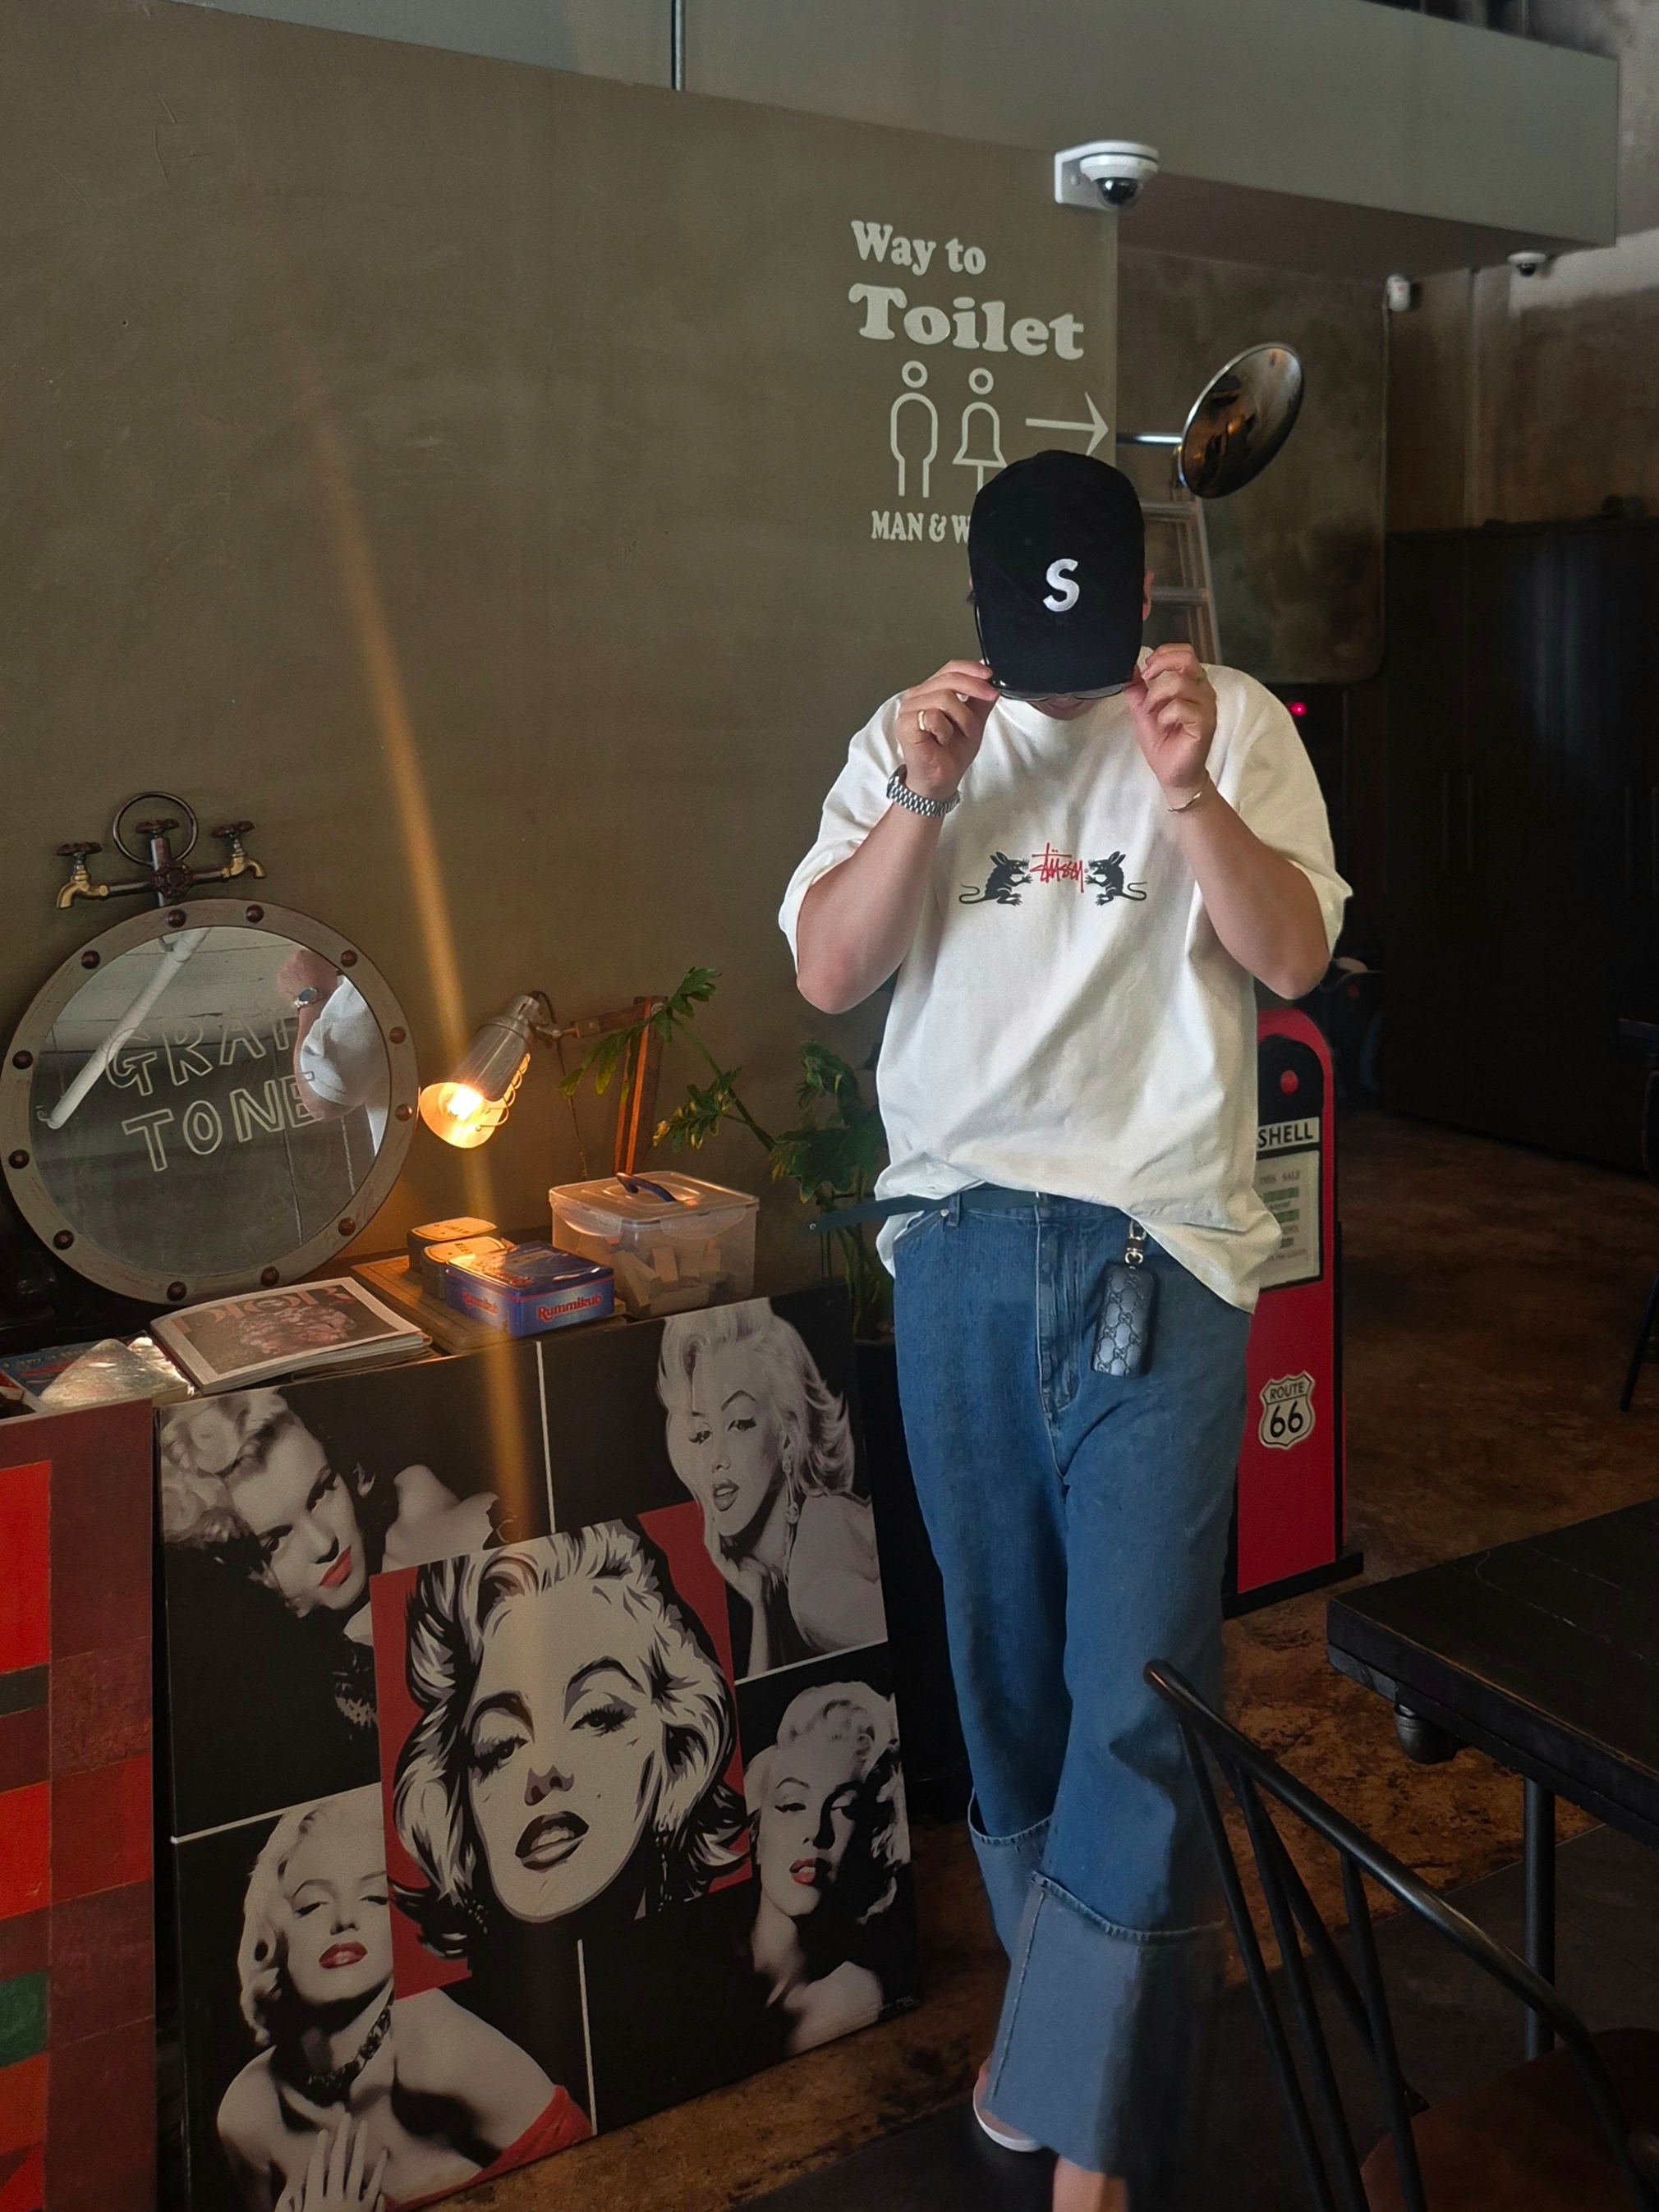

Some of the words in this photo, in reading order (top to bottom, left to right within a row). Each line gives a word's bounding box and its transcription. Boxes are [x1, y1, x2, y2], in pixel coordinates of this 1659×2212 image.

[851, 220, 937, 276] Way
[944, 237, 986, 275] to
[848, 282, 1085, 360] Toilet
[871, 510, 924, 542] MAN
[928, 513, 948, 543] &
[1042, 558, 1080, 613] S
[122, 1071, 324, 1173] TONE
[1257, 1120, 1313, 1148] SHELL
[537, 1292, 603, 1323] Rummikub
[1269, 1381, 1305, 1400] ROUTE
[1270, 1400, 1303, 1439] 66
